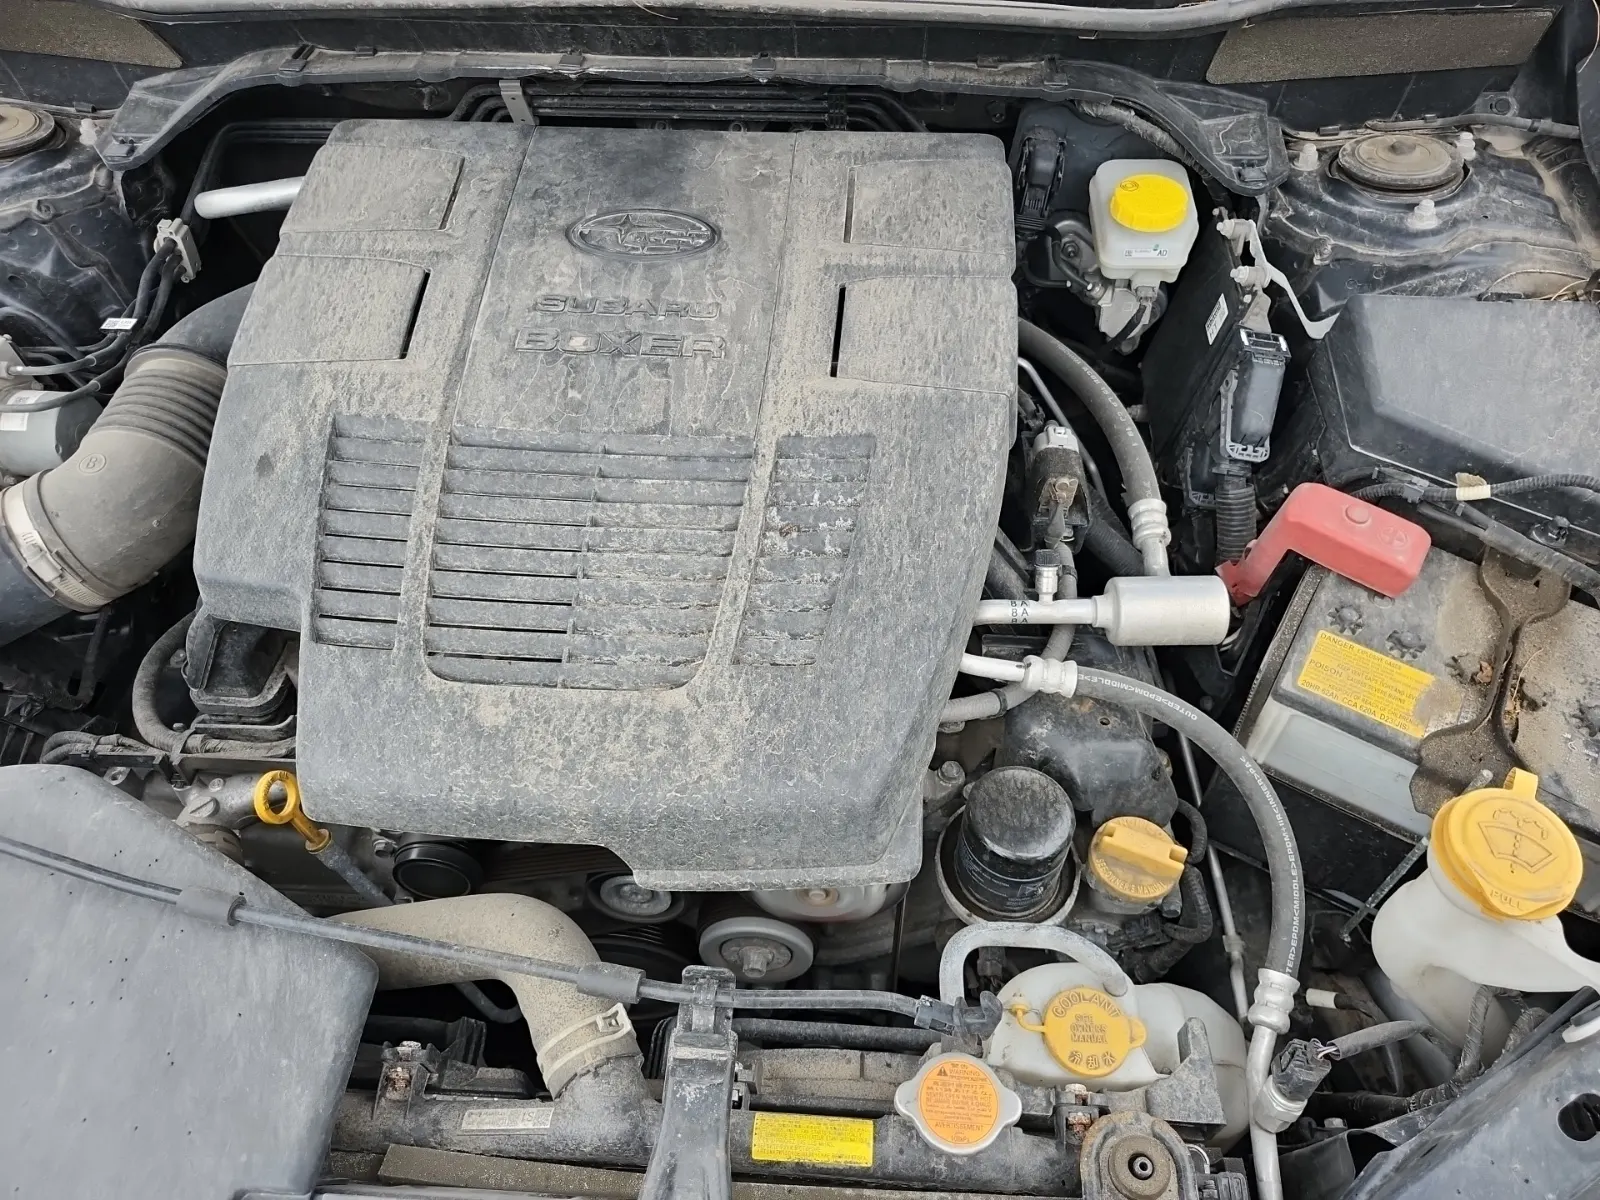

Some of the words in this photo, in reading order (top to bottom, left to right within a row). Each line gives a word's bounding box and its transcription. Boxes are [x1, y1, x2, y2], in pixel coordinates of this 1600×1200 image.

[536, 294, 720, 320] SUBARU
[515, 328, 726, 359] BOXER
[1320, 632, 1354, 651] DANGER
[1308, 658, 1343, 677] POISON
[1301, 679, 1320, 692] 20HR
[1320, 688, 1339, 700] 62Ah
[1341, 696, 1358, 708] CCA
[1358, 704, 1377, 716] 620A
[1490, 890, 1525, 912] PULL
[1052, 990, 1122, 1018] COOLANT
[1070, 1034, 1108, 1044] MANUAL
[1068, 1051, 1116, 1070] 冷却水
